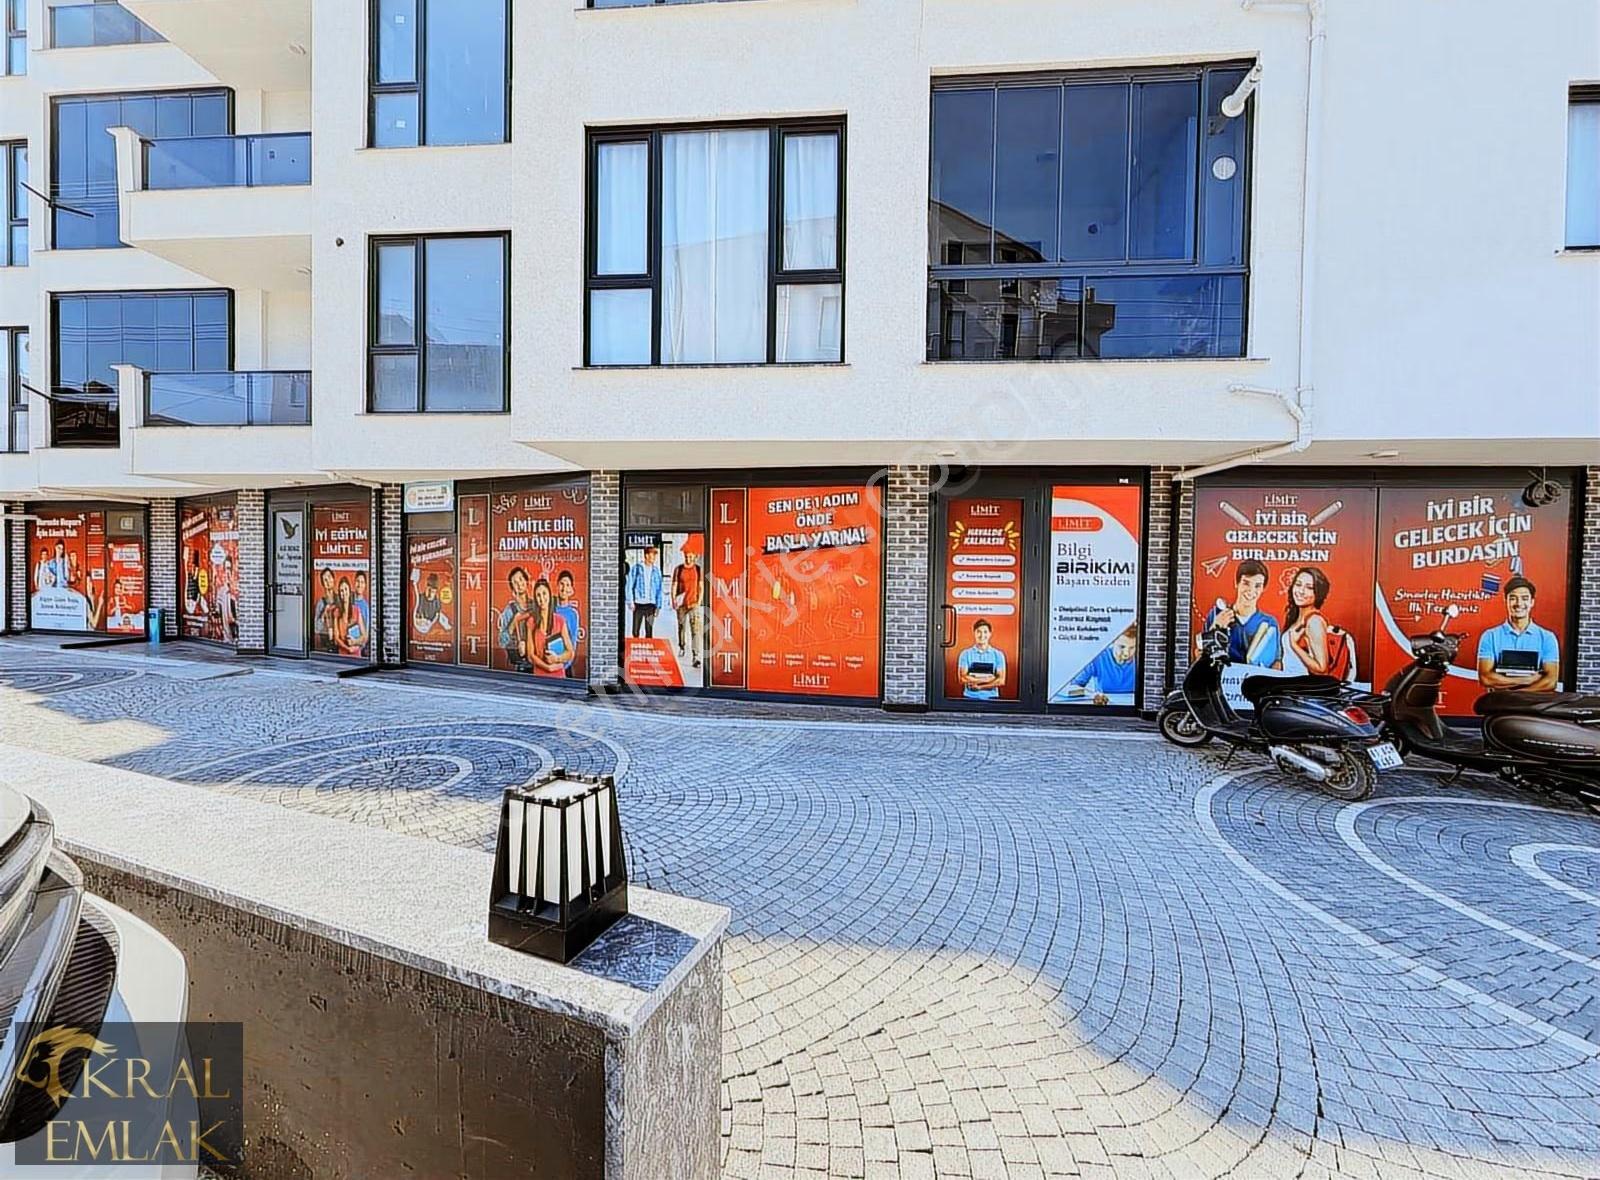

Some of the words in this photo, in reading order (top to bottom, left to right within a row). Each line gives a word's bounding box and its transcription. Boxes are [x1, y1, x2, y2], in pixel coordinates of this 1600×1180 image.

[768, 500, 791, 513] SEN
[795, 498, 811, 510] DE
[822, 493, 858, 507] ADIM
[1427, 498, 1454, 521] İYİ
[1459, 495, 1494, 517] BİR
[508, 516, 551, 533] LİMİTLE
[553, 515, 573, 532] BİR
[796, 513, 833, 527] ÖNDE
[1255, 509, 1277, 525] İYİ
[1281, 510, 1308, 526] BİR
[331, 527, 367, 540] EĞİTİM
[1225, 530, 1299, 544] GELECEK
[1302, 528, 1337, 547] İÇİN
[1395, 521, 1484, 549] GELECEK
[1488, 513, 1532, 538] İÇİN
[319, 542, 363, 555] LİMİTLE
[499, 537, 528, 551] ADIM
[531, 533, 584, 550] ÖNDESİN
[767, 533, 809, 553] BAŞLA
[1057, 542, 1092, 560] Bilgi
[1232, 548, 1330, 562] BURADASIN
[465, 507, 481, 654] LİMİT
[715, 502, 741, 674] LİMİT
[1056, 575, 1090, 588] Başarı
[1093, 575, 1131, 586] Sizden
[793, 672, 830, 685] LİMİT
